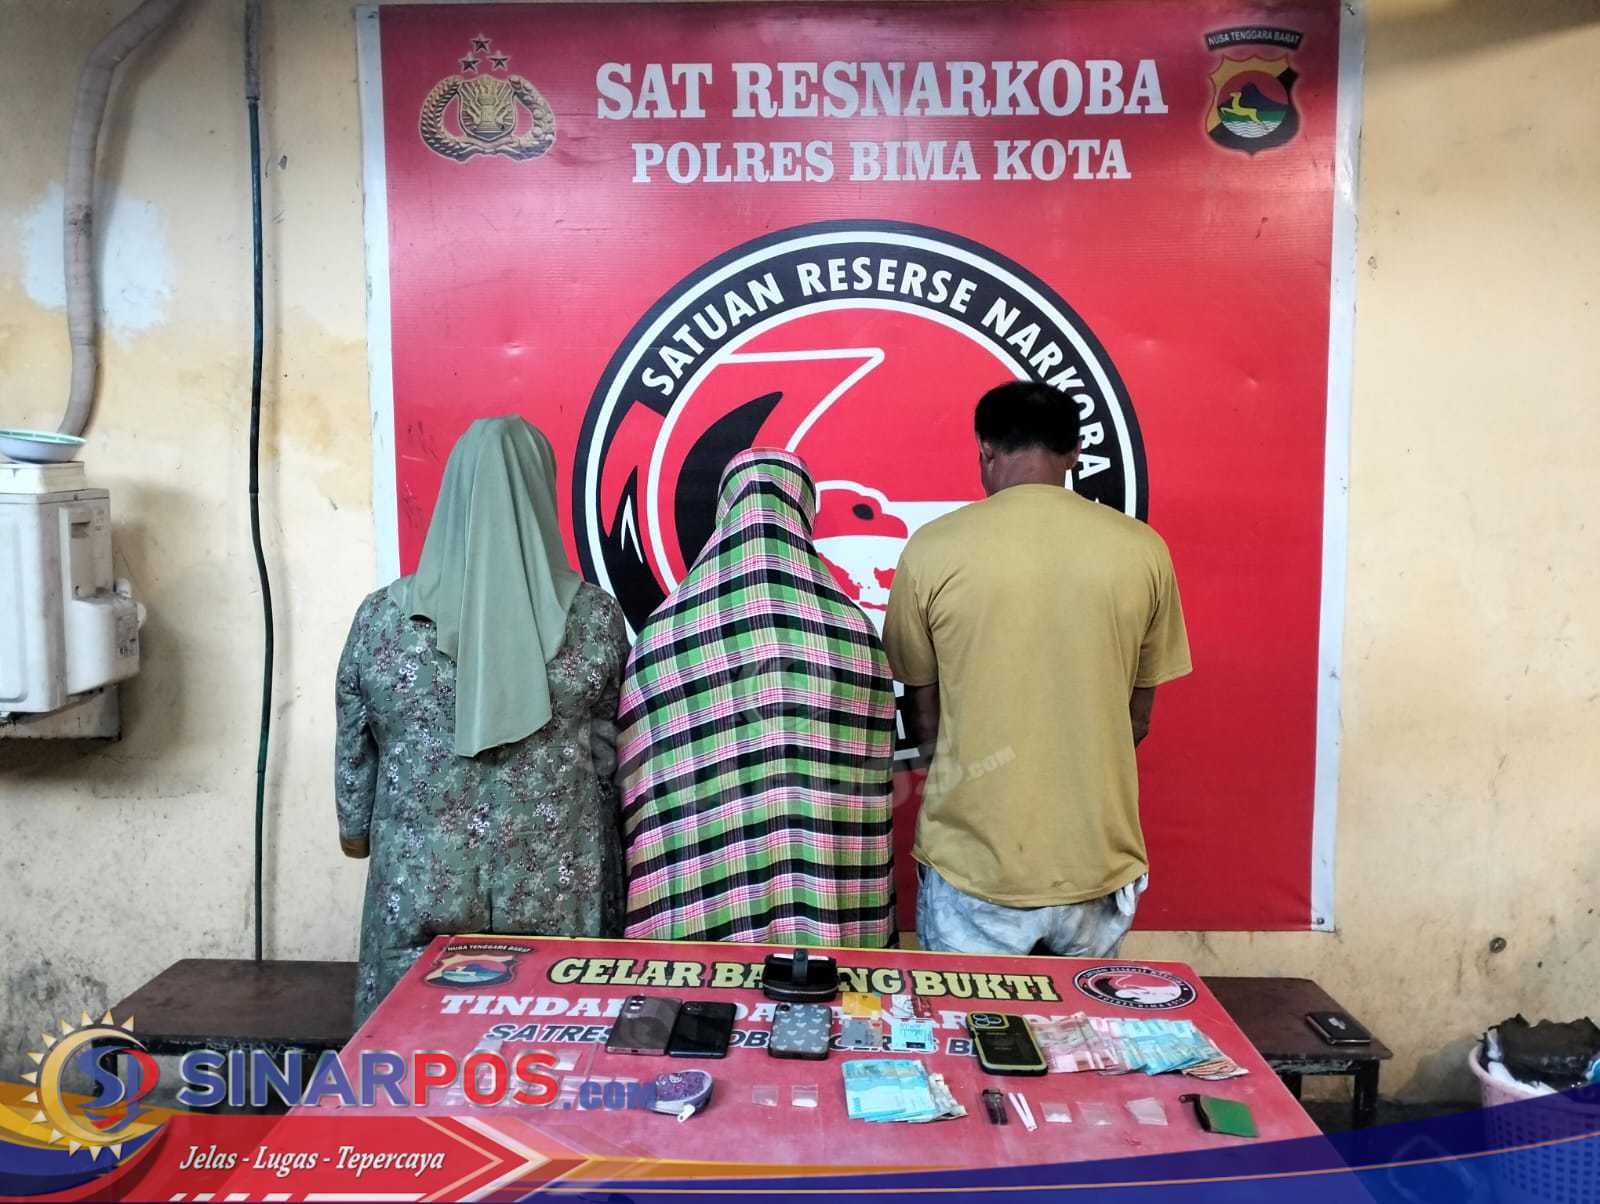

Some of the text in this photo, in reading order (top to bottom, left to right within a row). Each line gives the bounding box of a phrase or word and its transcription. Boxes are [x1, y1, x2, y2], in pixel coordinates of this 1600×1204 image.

[596, 59, 1169, 119] SAT RESNARKOBA
[632, 139, 1132, 184] POLRES BIMA KOTA
[640, 256, 1112, 480] SATUAN RESERSE NARKOBA
[549, 957, 702, 988] GELAR
[710, 961, 903, 995] BANG
[911, 969, 1062, 1002] BUKTI
